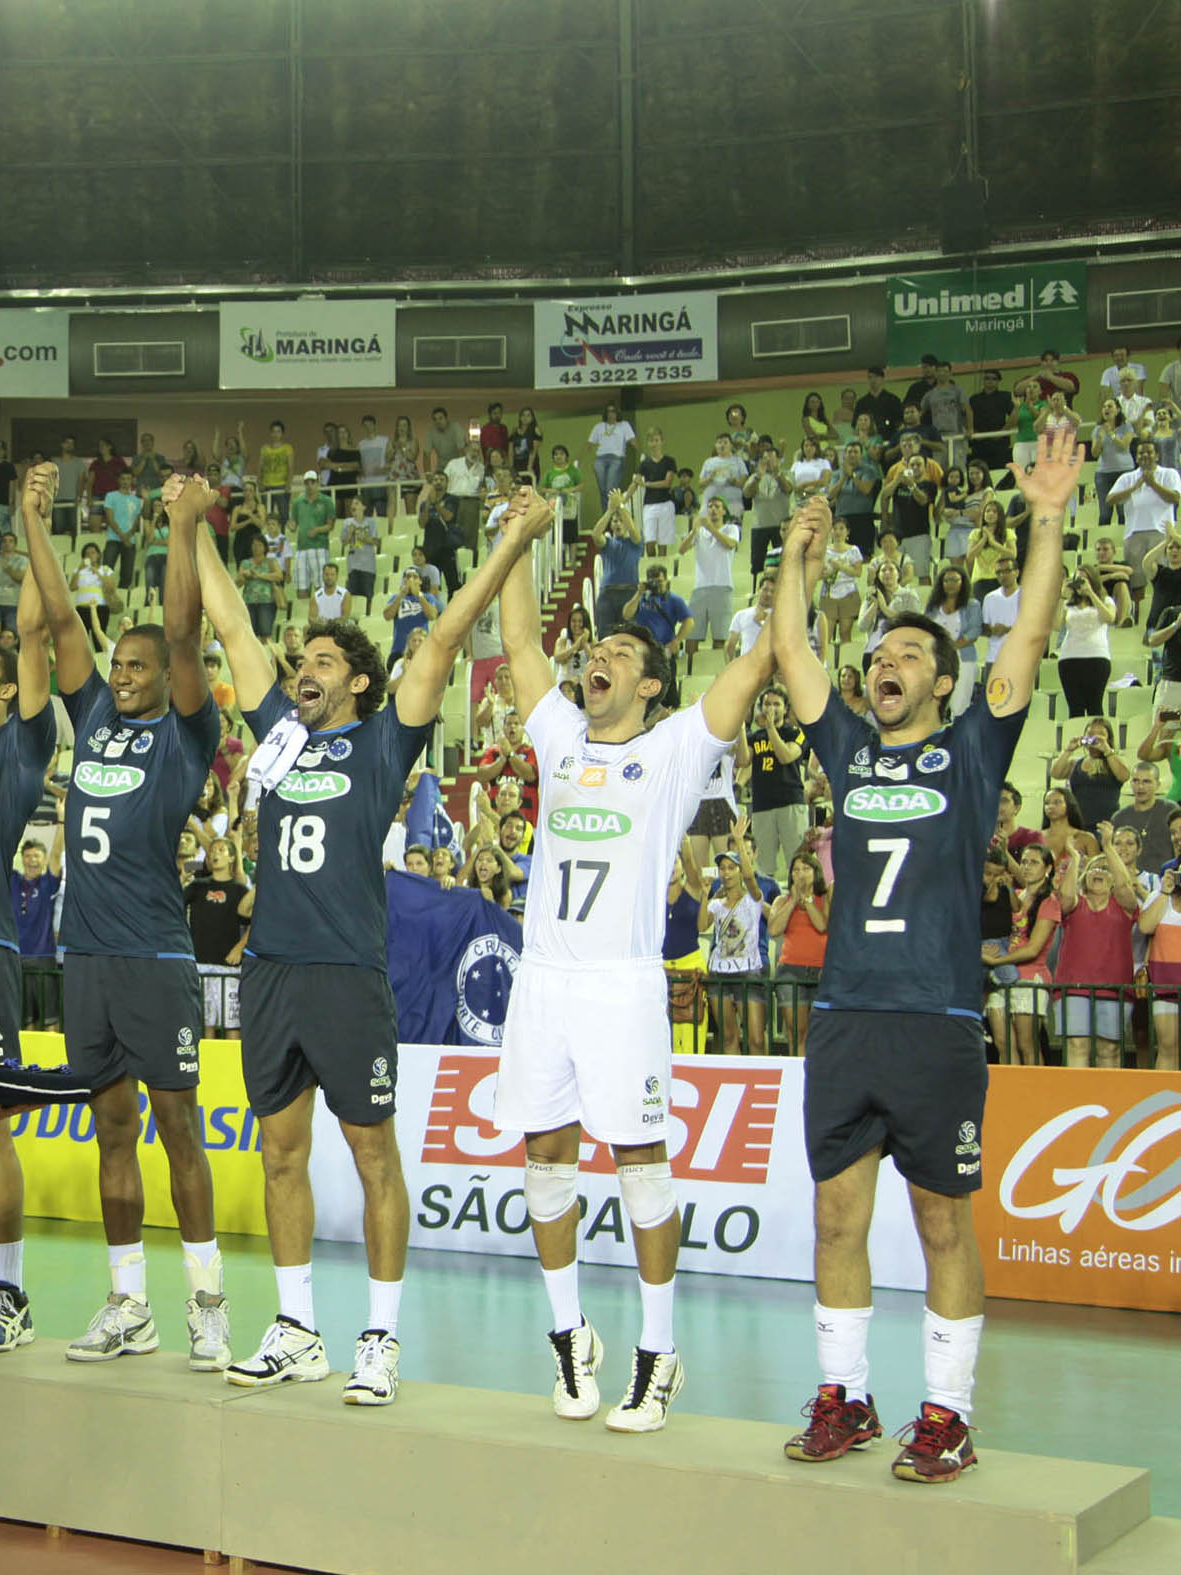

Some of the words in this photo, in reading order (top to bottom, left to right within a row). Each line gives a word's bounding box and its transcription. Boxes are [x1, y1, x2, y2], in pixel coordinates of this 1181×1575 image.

[894, 284, 1024, 317] Unimed
[564, 306, 692, 336] MARINGÁ
[965, 316, 1024, 332] Maringá
[276, 333, 381, 355] MARINGÁ
[560, 371, 582, 384] 44
[590, 368, 637, 383] 3222
[645, 365, 692, 380] 7535
[79, 766, 132, 787] SADA
[762, 757, 774, 771] 12
[279, 776, 338, 793] SADA
[851, 792, 932, 811] SADA
[81, 806, 111, 864] 5
[552, 811, 622, 833] SADA
[278, 815, 326, 874] 18
[866, 838, 910, 907] 7
[556, 859, 611, 922] 17
[417, 1174, 533, 1236] SÃO
[998, 1237, 1071, 1266] Linhas
[1080, 1245, 1160, 1272] aéreas
